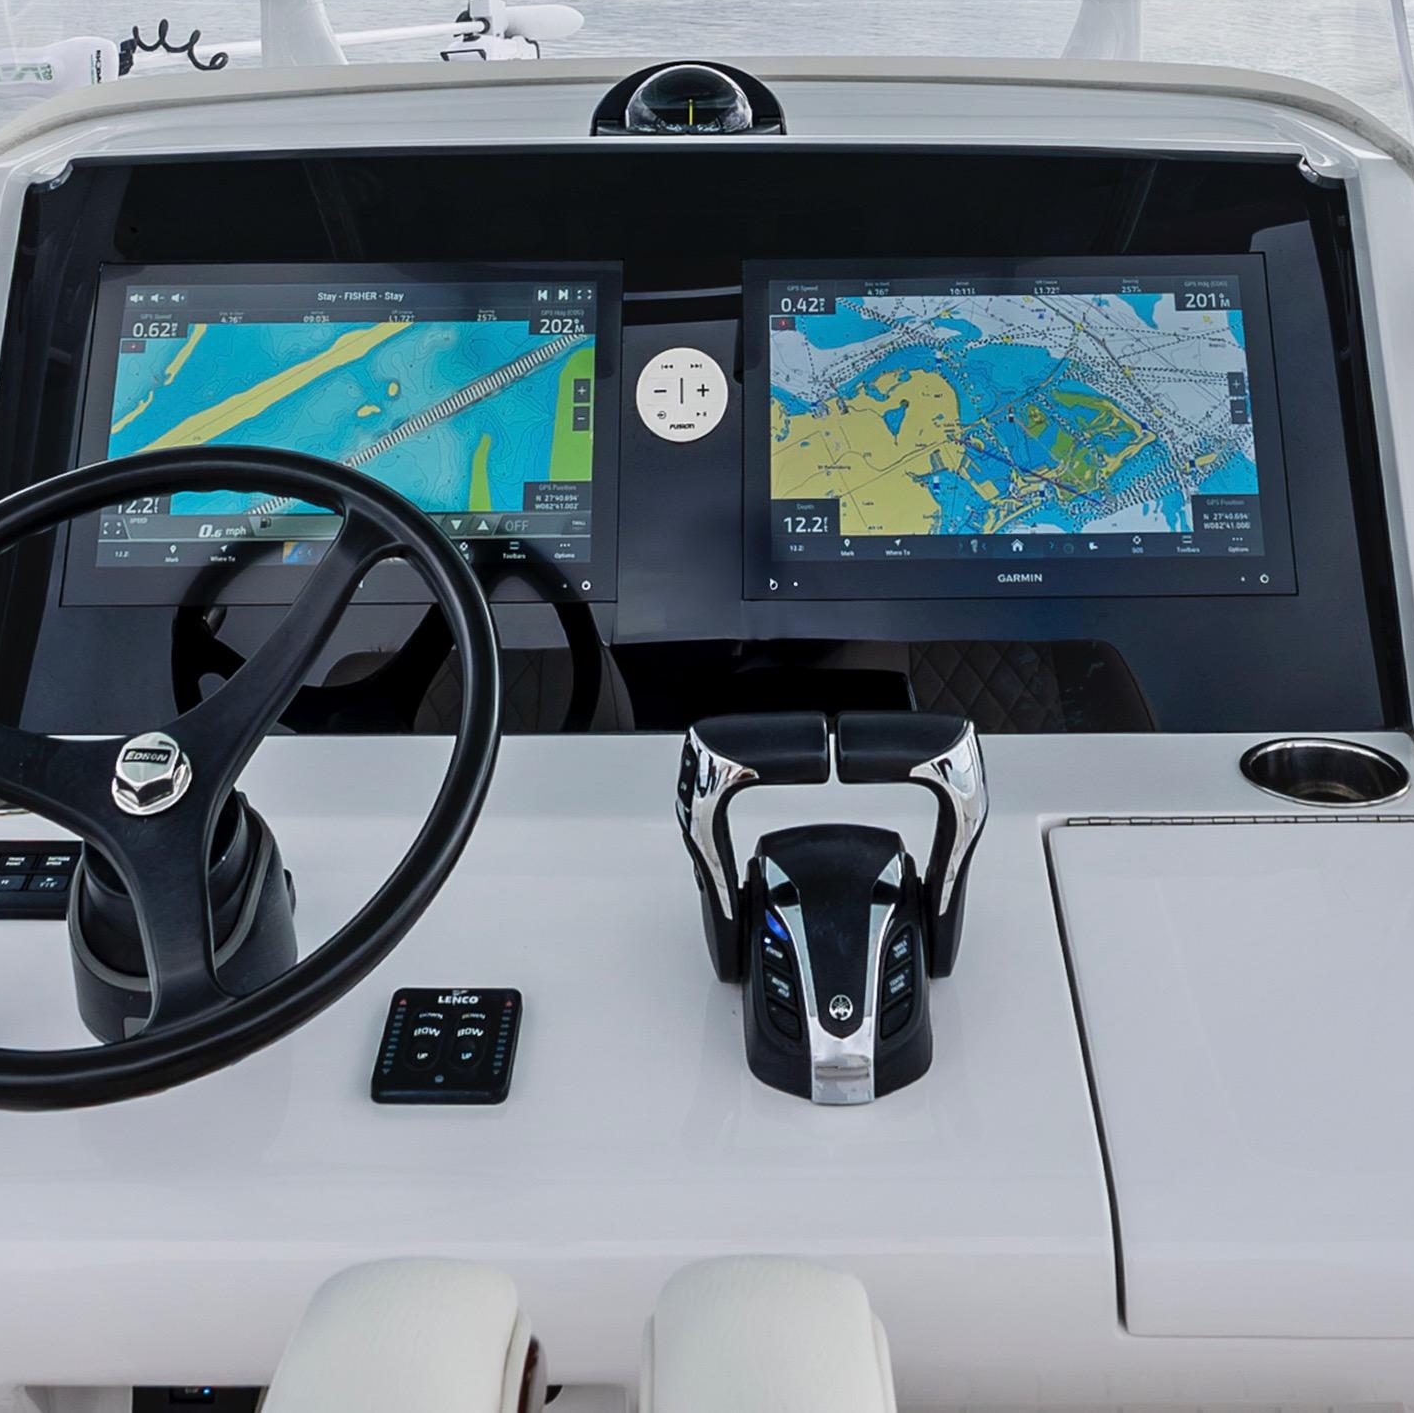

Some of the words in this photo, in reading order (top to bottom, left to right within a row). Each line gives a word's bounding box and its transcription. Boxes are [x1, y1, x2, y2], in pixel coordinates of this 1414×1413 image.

[317, 292, 337, 303] Stay
[344, 291, 377, 301] FISHER
[384, 292, 404, 302] Stay
[1185, 293, 1217, 308] 201
[780, 297, 819, 313] 0.42
[132, 322, 171, 337] 0.62
[539, 319, 574, 334] 202
[505, 520, 529, 531] OFF
[783, 516, 823, 533] 12.2
[198, 524, 222, 538] 0.6
[225, 526, 247, 537] mph
[997, 573, 1043, 583] GARMIN
[437, 995, 479, 1004] LENCO
[414, 1027, 440, 1037] BOW
[457, 1027, 484, 1037] BOW
[416, 1052, 429, 1060] UP
[461, 1052, 473, 1060] UP
